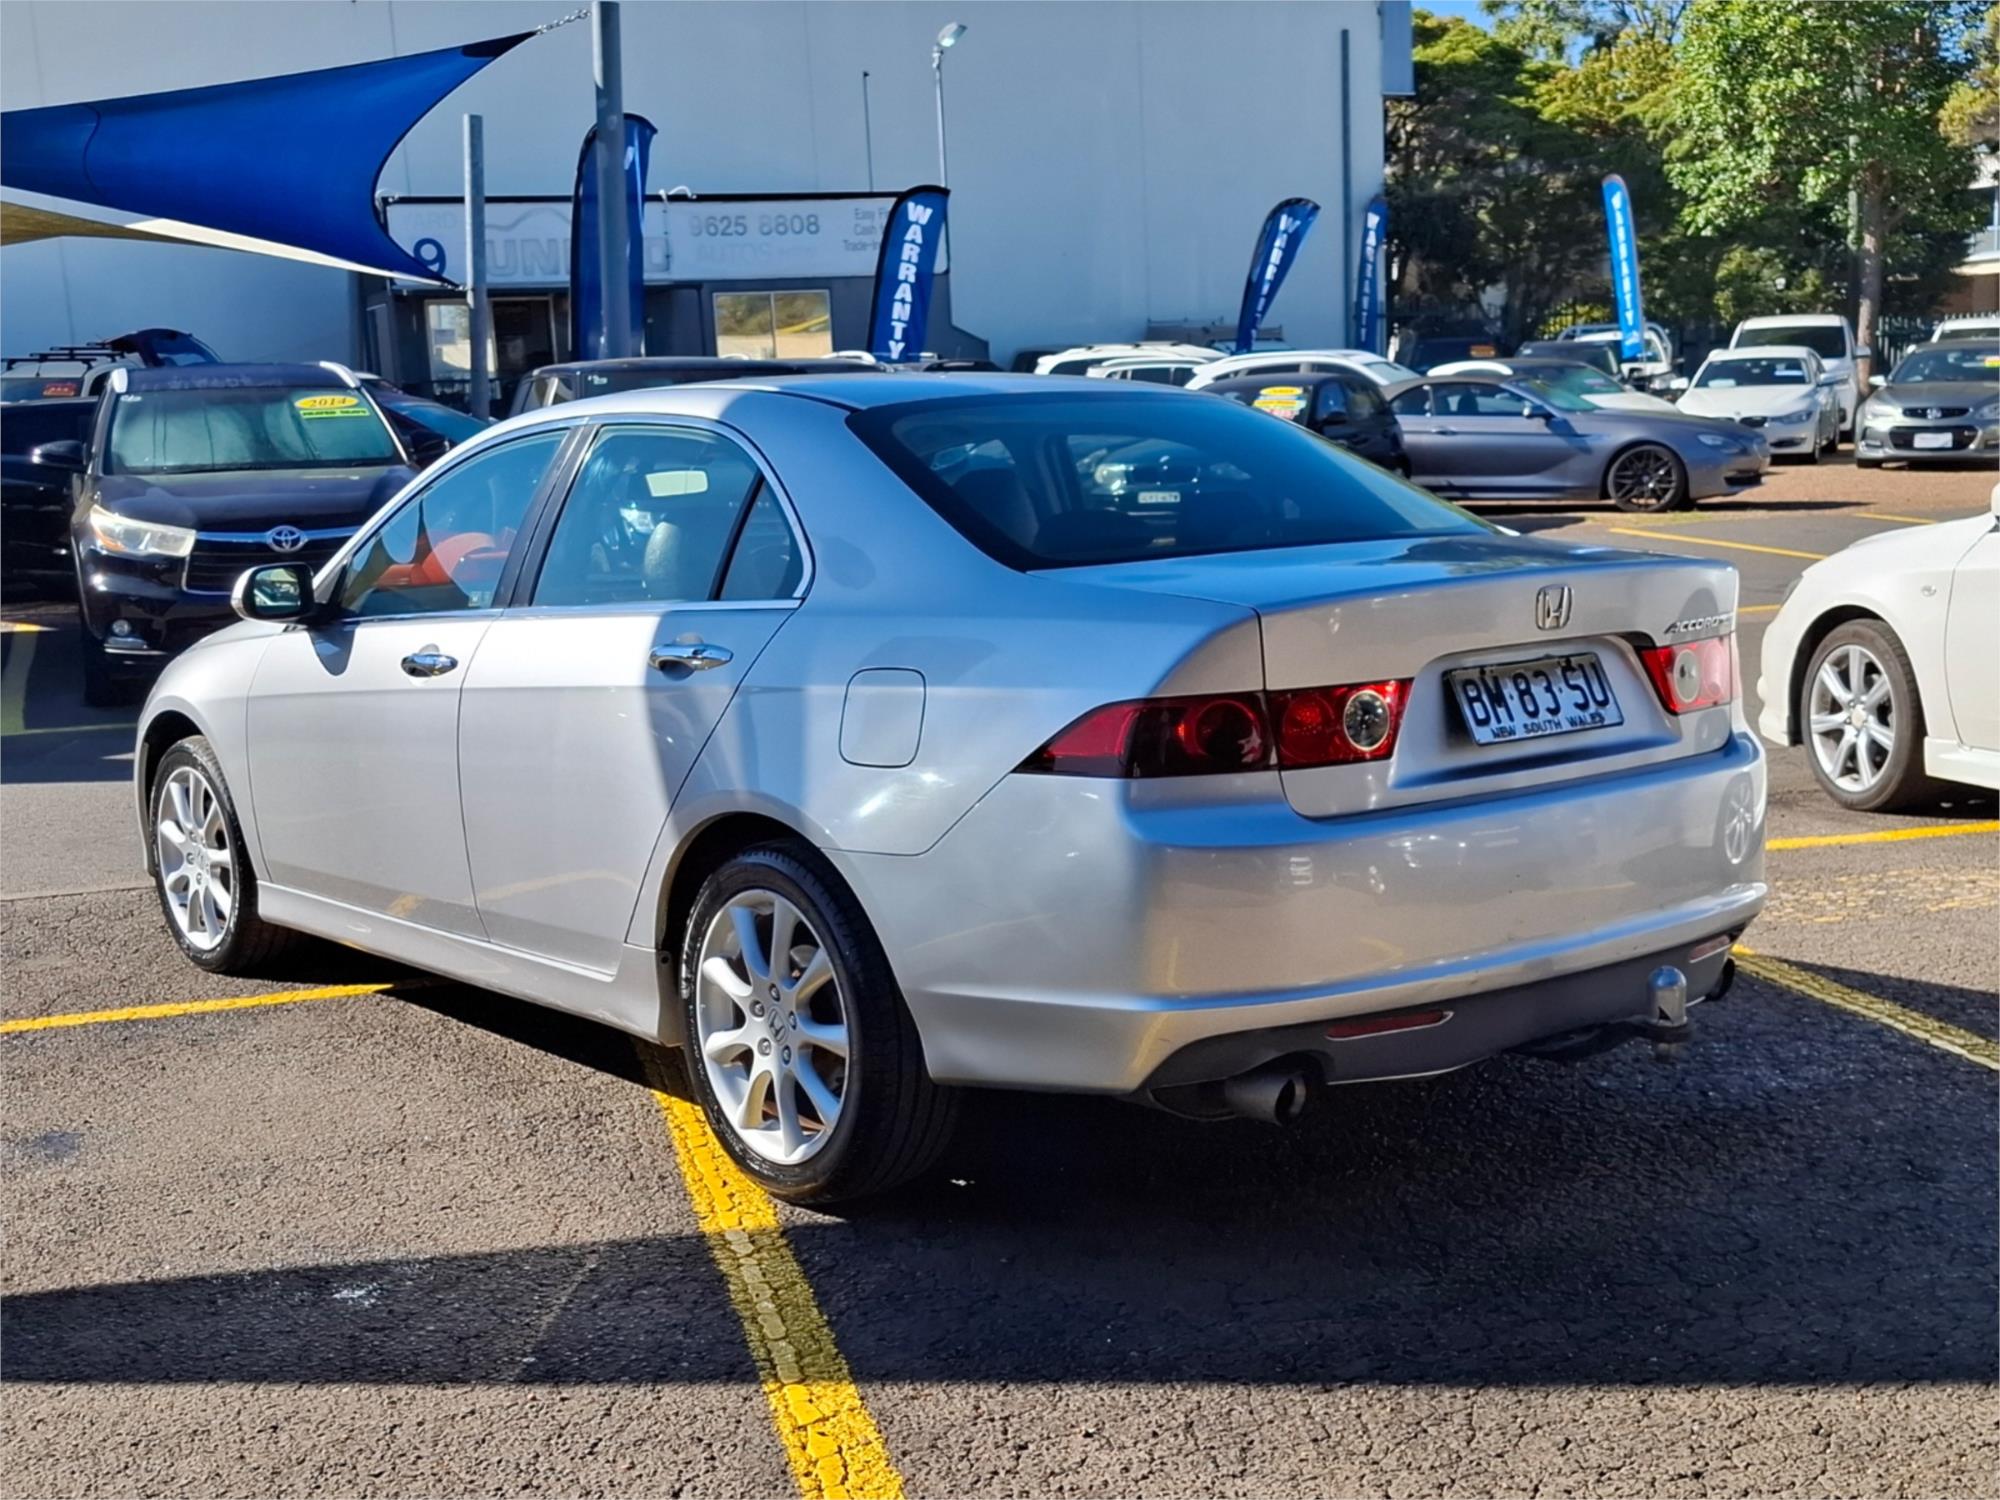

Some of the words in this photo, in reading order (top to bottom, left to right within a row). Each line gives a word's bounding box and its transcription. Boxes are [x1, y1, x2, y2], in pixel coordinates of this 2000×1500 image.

[689, 214, 748, 238] 9625
[759, 213, 821, 237] 8808
[413, 237, 447, 277] 9
[1610, 190, 1634, 327] WARRANTY
[887, 201, 934, 360] WARRANTY
[1361, 211, 1381, 342] WARRANTY
[308, 397, 347, 408] 2014
[1663, 615, 1720, 635] ACCORD
[1490, 725, 1518, 739] NEW
[1522, 719, 1563, 735] SOUTH
[1565, 711, 1606, 728] WALES
